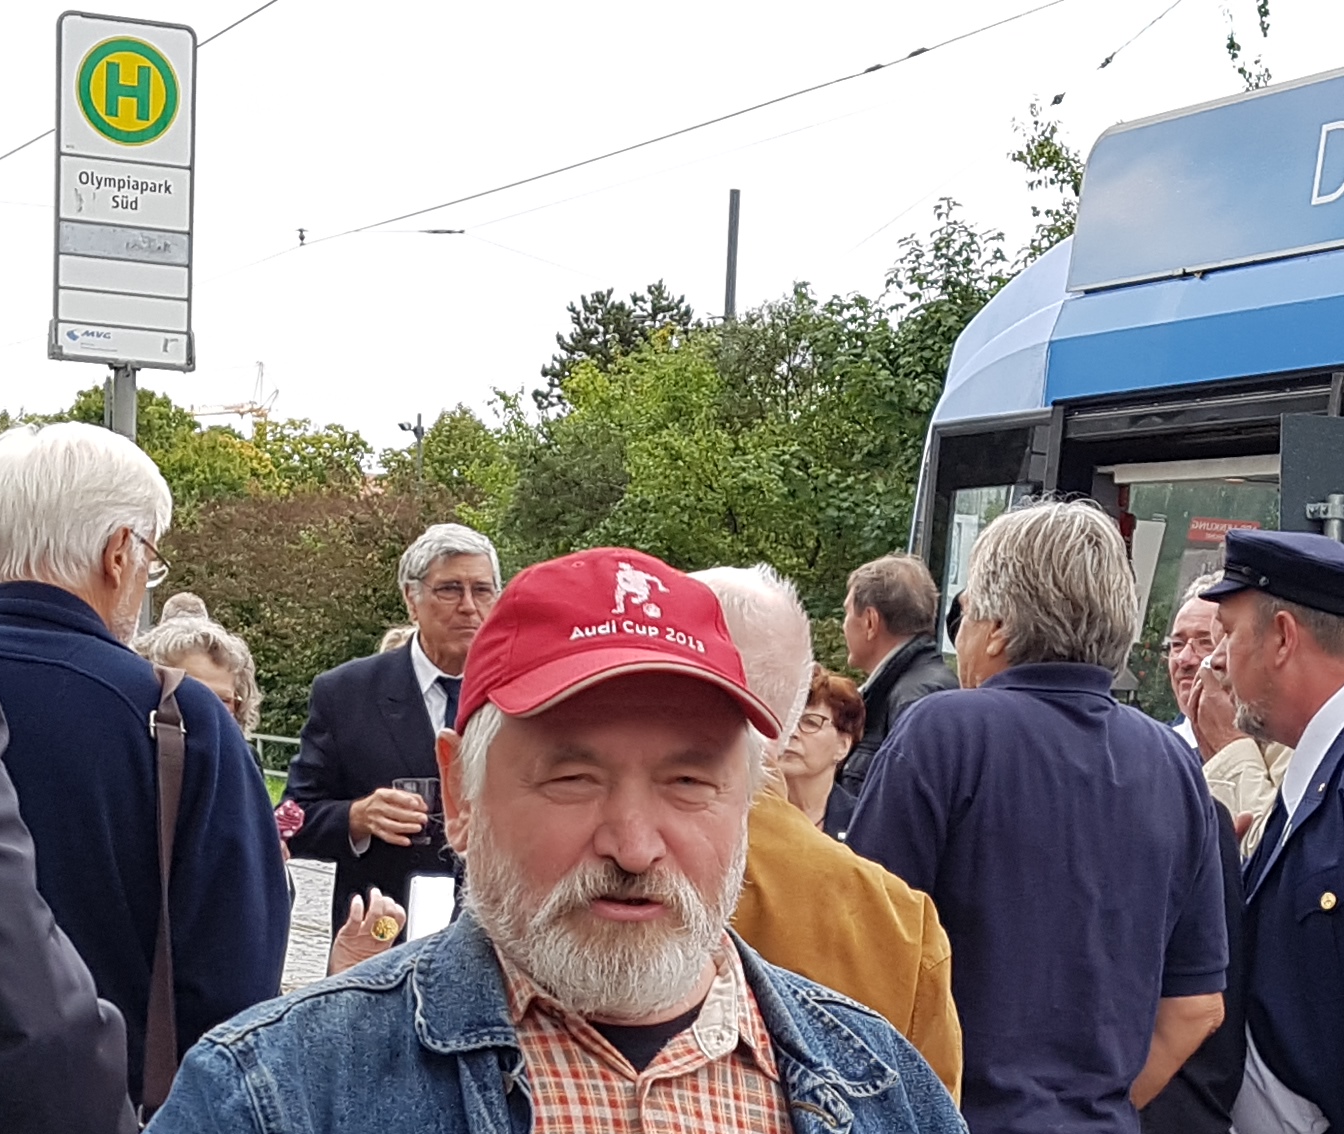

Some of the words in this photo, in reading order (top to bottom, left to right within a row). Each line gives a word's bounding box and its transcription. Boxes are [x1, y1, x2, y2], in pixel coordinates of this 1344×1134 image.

[105, 60, 151, 122] H
[78, 170, 173, 197] Olympiapark
[111, 194, 139, 212] Süd
[81, 329, 112, 340] MVG
[569, 620, 617, 641] Audi
[622, 620, 660, 637] Cup
